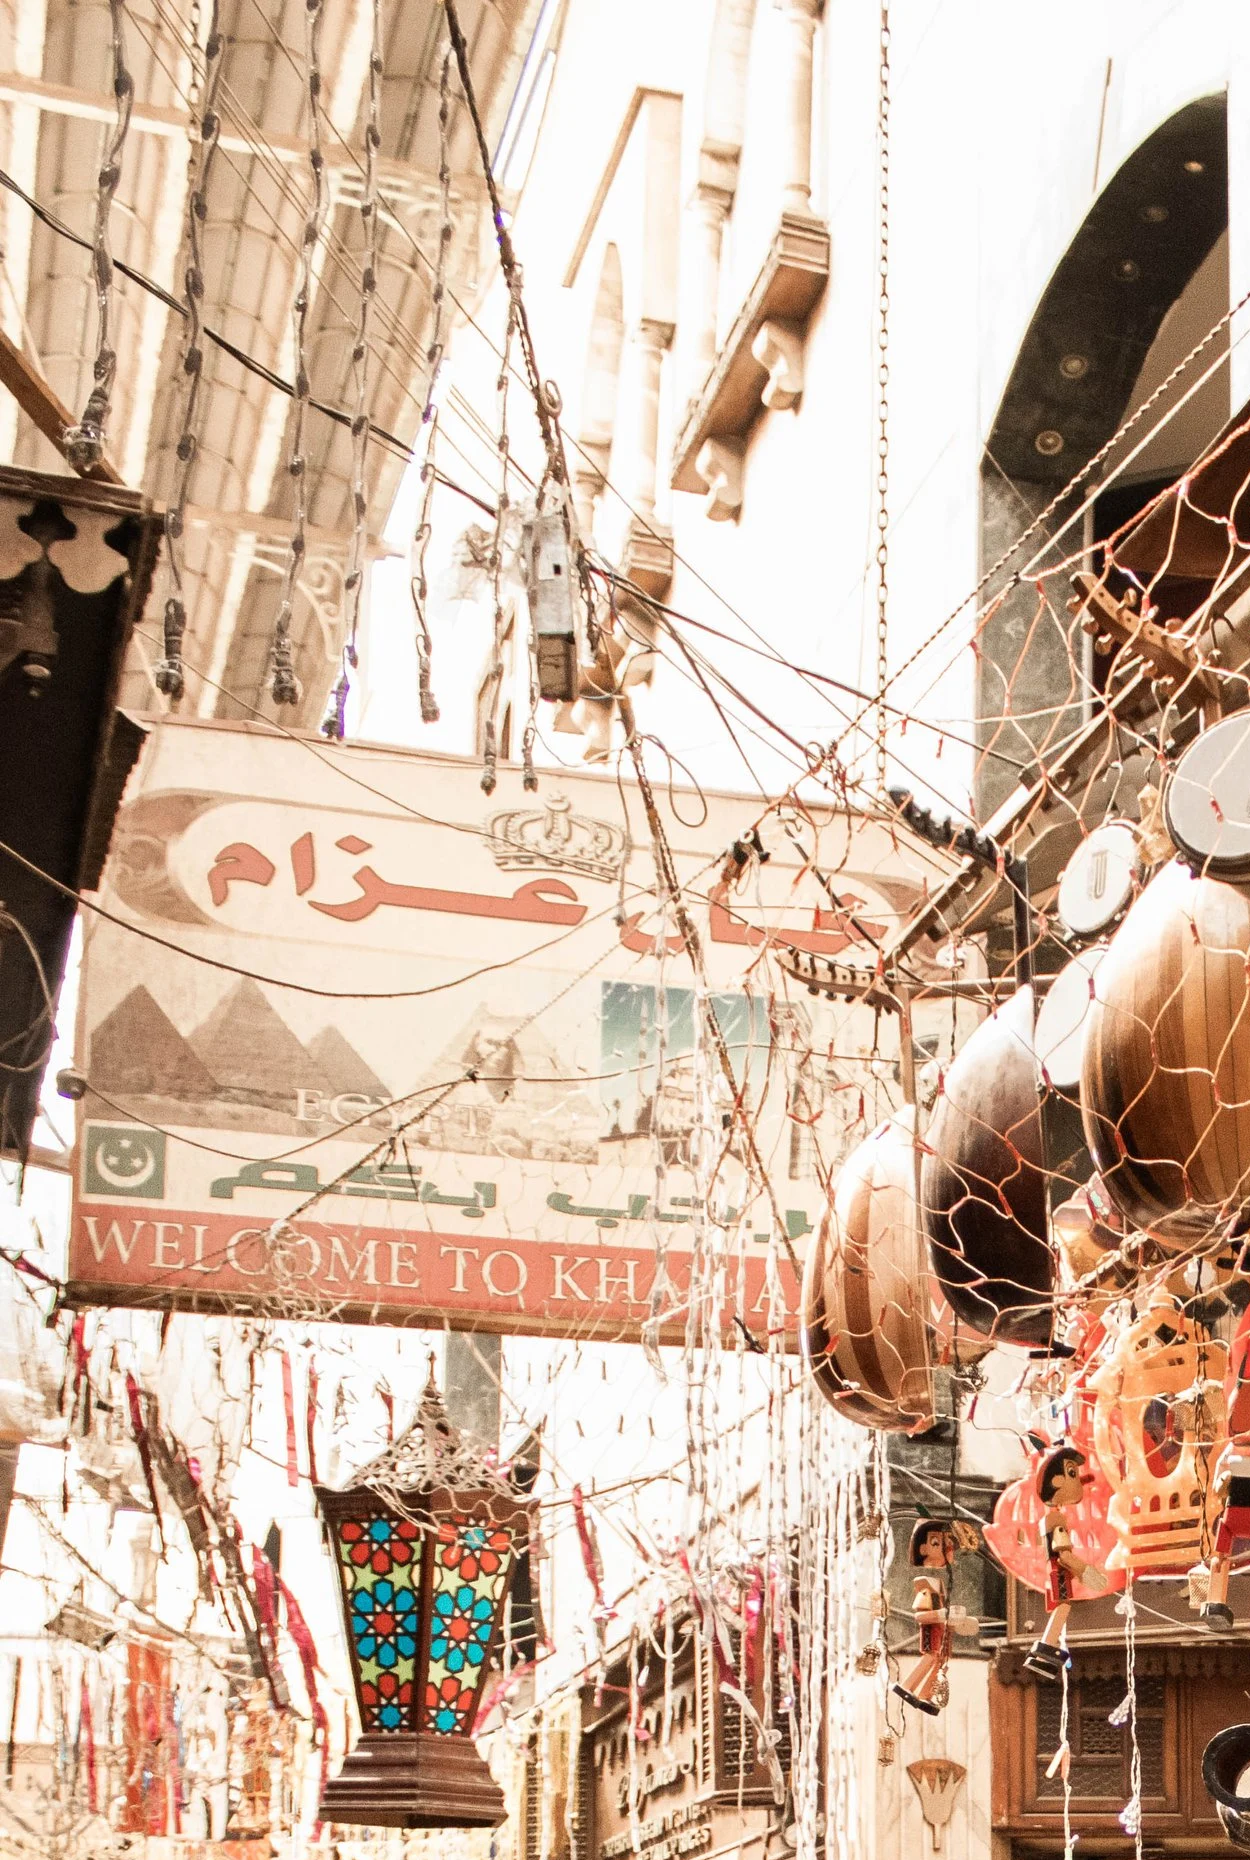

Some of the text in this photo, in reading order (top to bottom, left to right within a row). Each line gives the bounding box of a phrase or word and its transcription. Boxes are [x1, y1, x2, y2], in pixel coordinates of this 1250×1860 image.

[207, 831, 589, 923] عزام
[290, 1087, 495, 1140] EGYPT
[80, 1215, 421, 1290] WELCOME
[439, 1245, 529, 1298] TO
